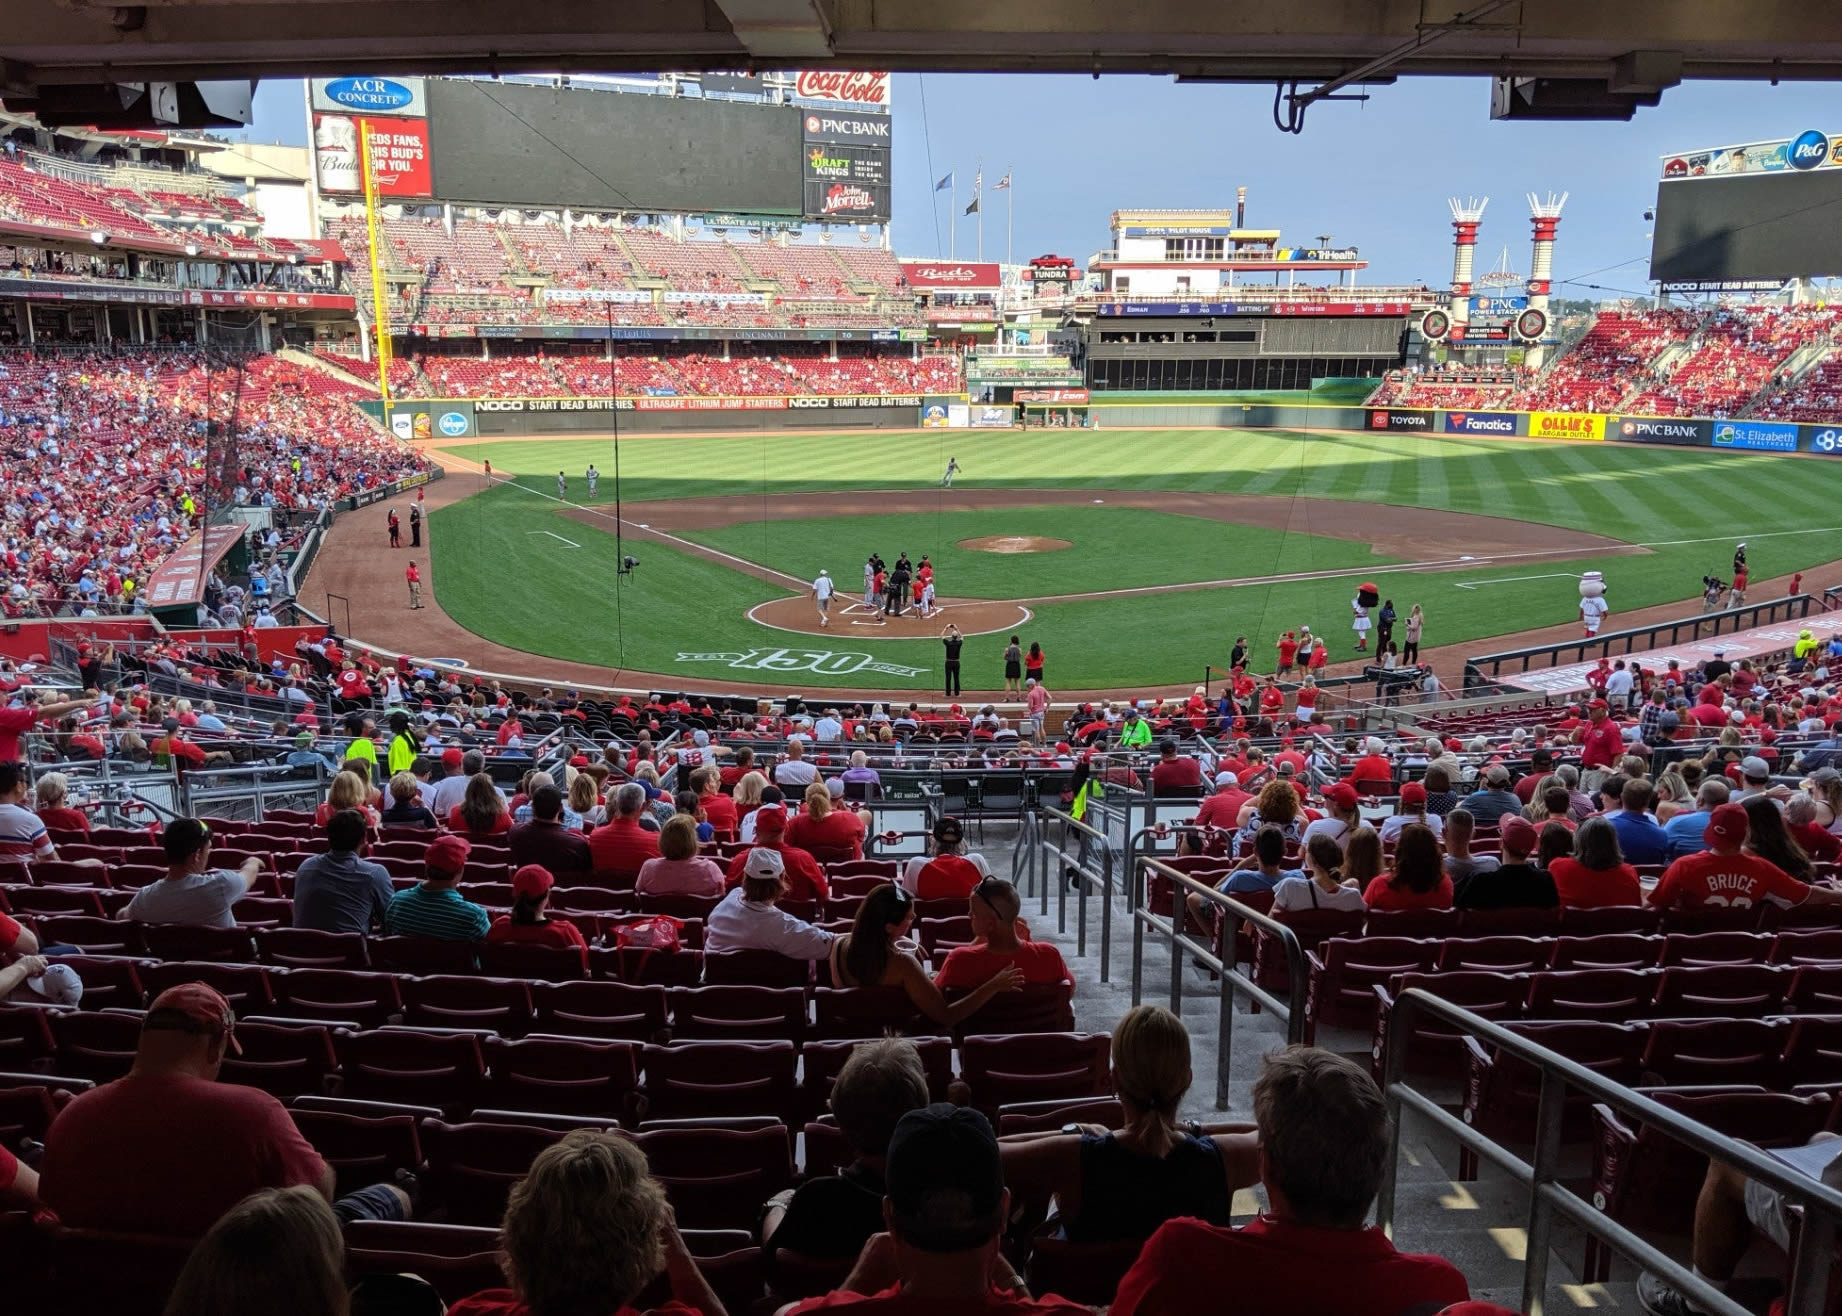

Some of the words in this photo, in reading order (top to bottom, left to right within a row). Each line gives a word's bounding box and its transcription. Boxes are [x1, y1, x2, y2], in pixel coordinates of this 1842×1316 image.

[352, 80, 386, 92] ACR
[337, 92, 400, 105] CONCRETE
[821, 119, 851, 134] PNC
[851, 122, 889, 136] BANK
[367, 133, 391, 145] EDS
[393, 134, 423, 148] FANS,
[371, 146, 389, 158] HIS
[391, 147, 423, 160] BUD'S
[1795, 142, 1825, 158] P&G
[388, 160, 414, 172] YOU.
[811, 158, 850, 169] DRAFT
[816, 166, 849, 176] KINGS
[840, 186, 862, 197] John
[821, 193, 874, 212] Morrell
[705, 218, 746, 226] ULTIMATE
[762, 220, 799, 228] SHUTTLE
[1316, 250, 1357, 260] TriHealth
[915, 267, 977, 279] Reds
[1662, 283, 1698, 291] NOCO
[1699, 281, 1721, 290] START
[1722, 281, 1742, 289] DEAD
[1490, 298, 1517, 308] PNC
[475, 401, 524, 411] NOCO
[529, 401, 558, 411] START
[560, 400, 584, 410] DEAD
[640, 400, 684, 409] ULTRASAFE
[688, 399, 720, 408] LITHIUM
[722, 399, 744, 408] JUMP
[789, 398, 829, 408] NOCO
[833, 398, 857, 407] START
[859, 397, 879, 406] DEAD
[1391, 415, 1426, 425] TOYOTA
[1466, 418, 1512, 431] Fanatics
[1537, 430, 1567, 438] BARGAIN
[1570, 431, 1595, 439] OUTLET
[1636, 423, 1663, 436] PNC
[1664, 424, 1698, 438] BANK
[1748, 430, 1795, 442] Elizabeth
[1706, 874, 1758, 894] BRUCE
